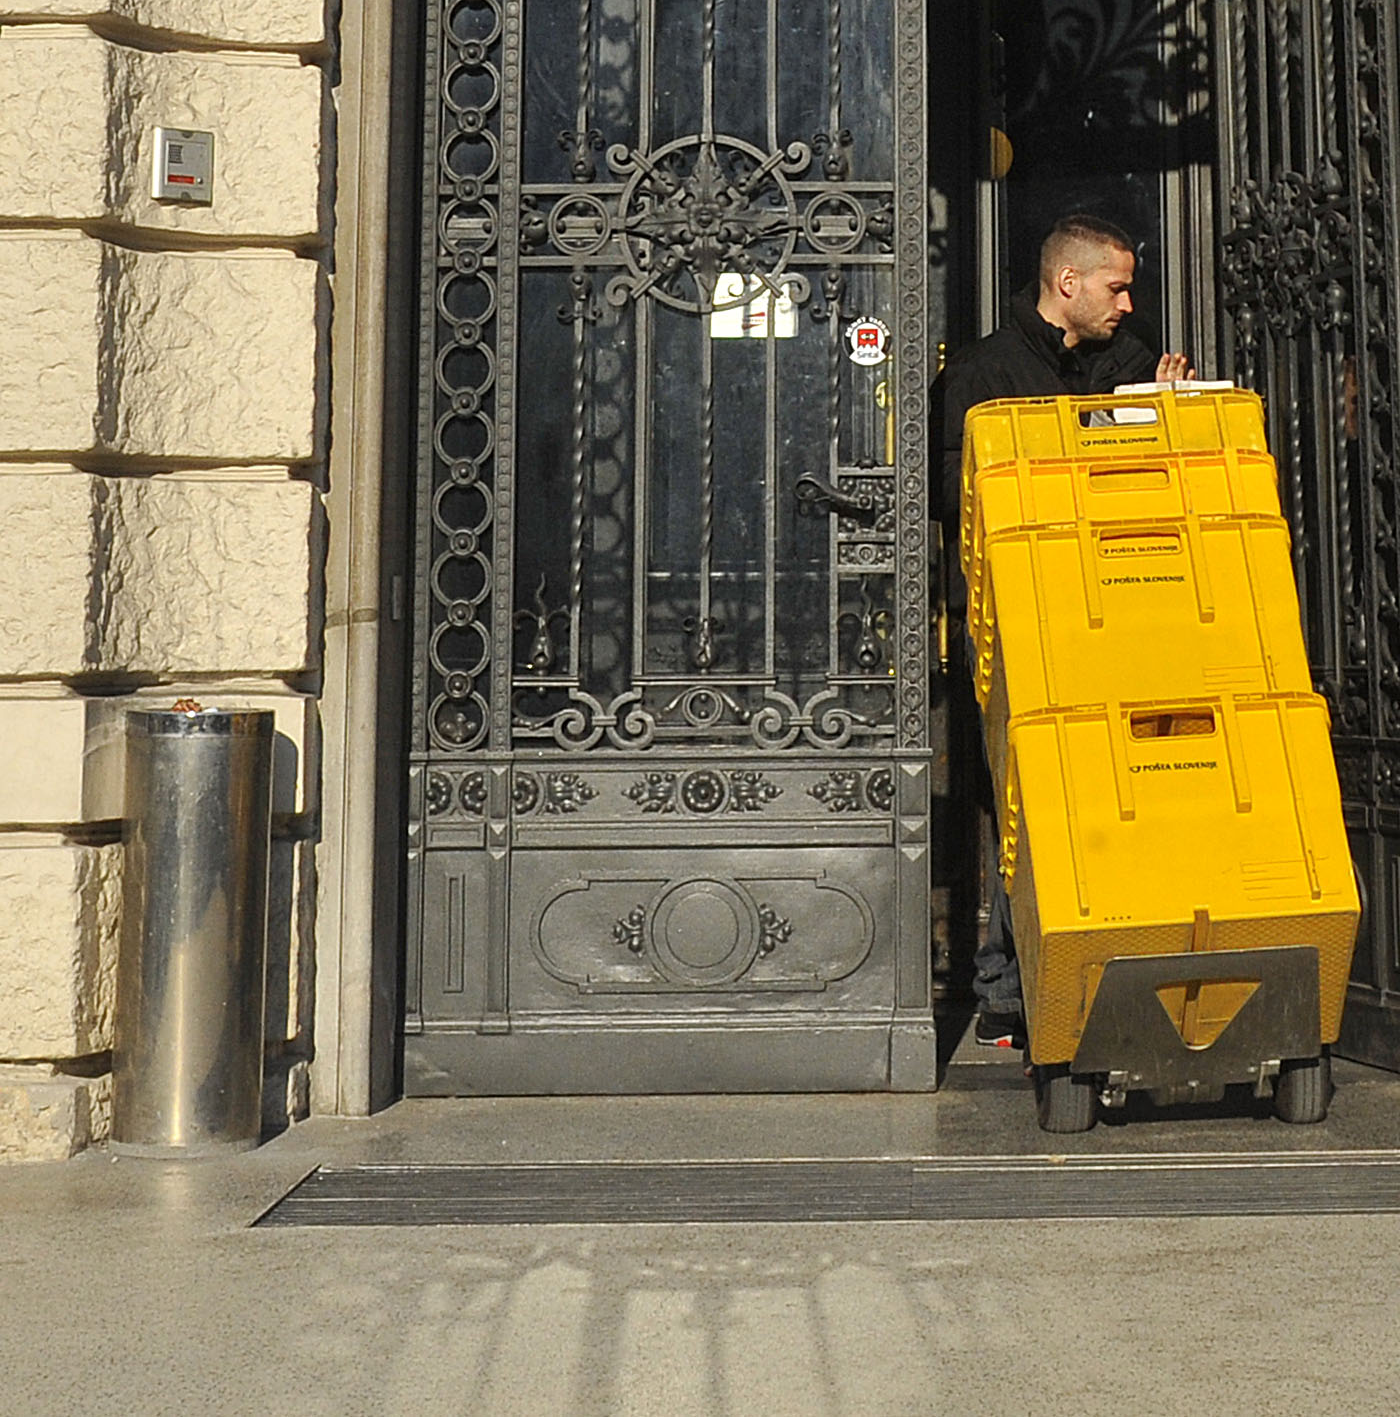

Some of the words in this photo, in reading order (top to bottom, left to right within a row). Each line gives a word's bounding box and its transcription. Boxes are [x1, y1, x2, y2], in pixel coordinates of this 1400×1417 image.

[1119, 436, 1158, 444] SLOVENIJE
[1113, 576, 1141, 584] POŠTA
[1143, 575, 1185, 583] SLOVENIJE
[1143, 763, 1171, 772] POŠTA
[1174, 761, 1218, 770] SLOVENIJE
